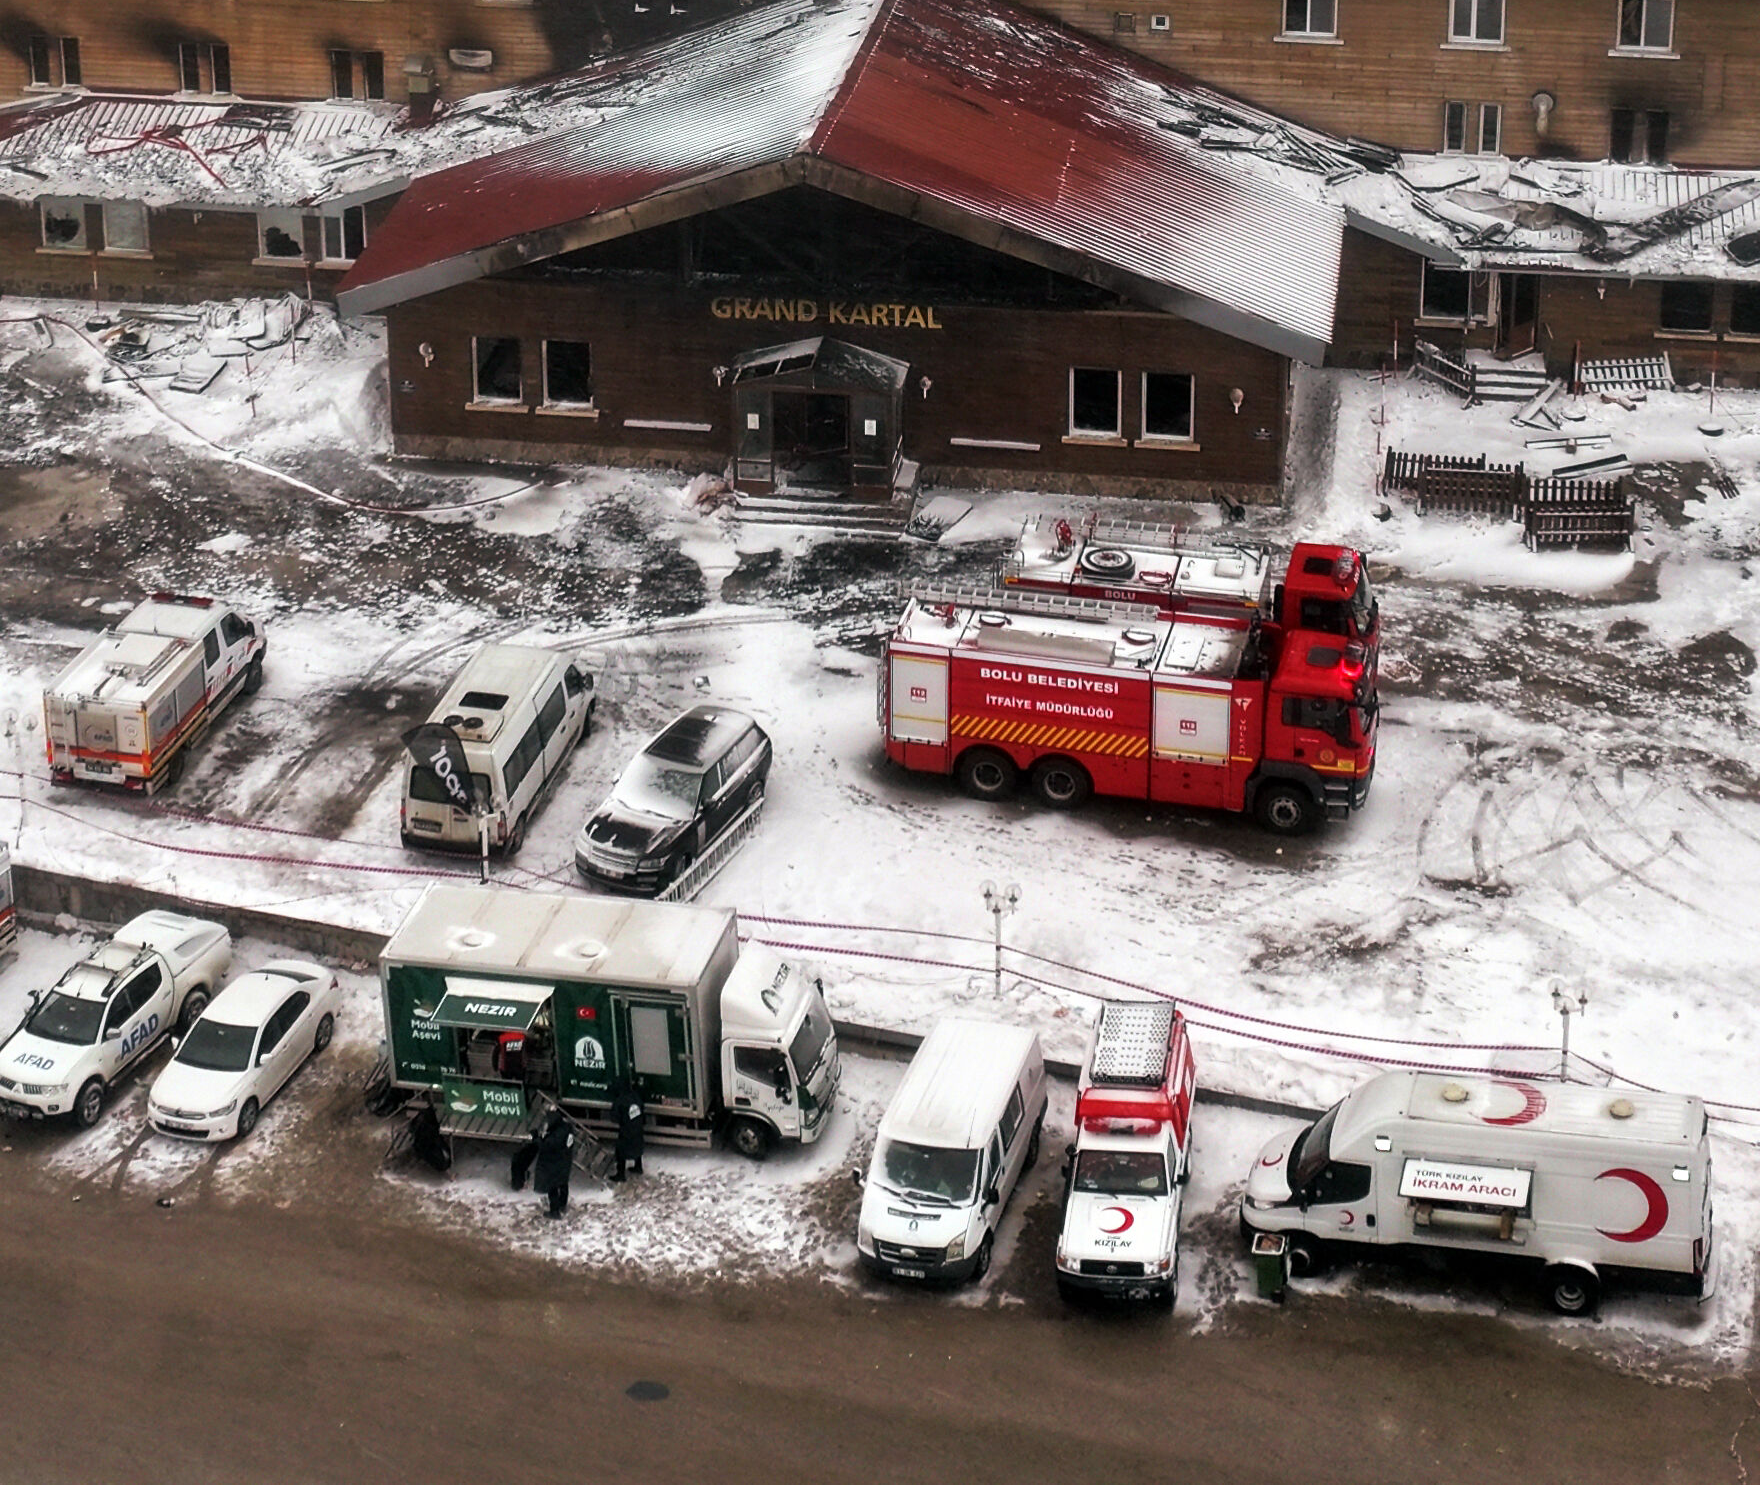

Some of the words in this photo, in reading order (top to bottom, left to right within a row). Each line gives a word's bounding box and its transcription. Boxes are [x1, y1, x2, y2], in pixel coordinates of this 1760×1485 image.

[711, 297, 818, 322] GRAND
[828, 300, 943, 329] KARTAL
[1104, 590, 1136, 600] BOLU
[980, 667, 1023, 683] BOLU
[1027, 673, 1120, 695] BELEDİYESİ
[985, 693, 1032, 710] İTFAİYE
[1035, 701, 1114, 720] MÜDÜRLÜĞÜ
[119, 1013, 159, 1061] AFAD
[13, 1053, 55, 1071] AFAD
[482, 1090, 519, 1104] Mobil
[1412, 1177, 1464, 1192] İKRAM
[1468, 1184, 1517, 1197] ARACI
[1446, 1173, 1484, 1183] KIZILAY
[1094, 1239, 1132, 1248] KIZILAY
